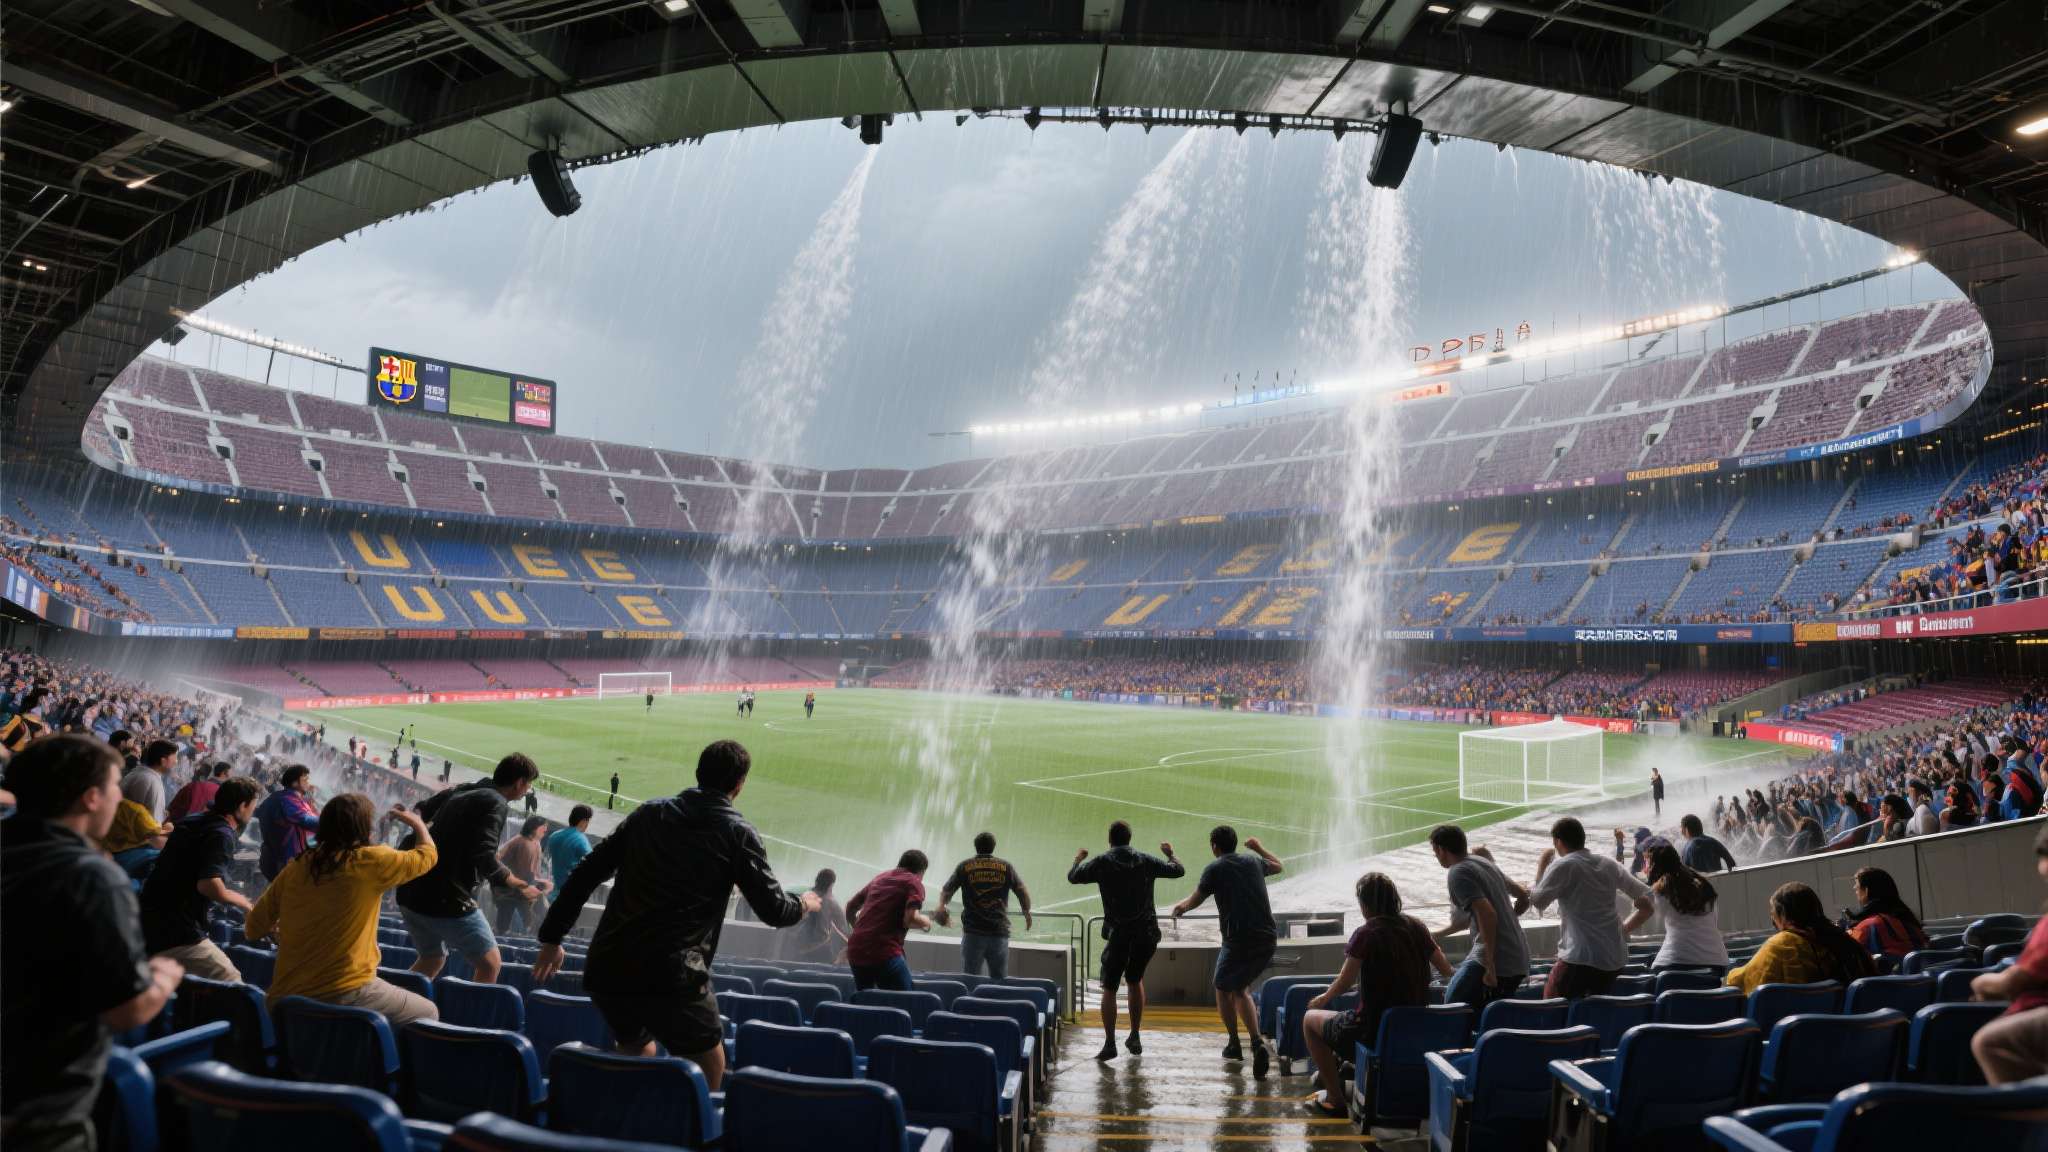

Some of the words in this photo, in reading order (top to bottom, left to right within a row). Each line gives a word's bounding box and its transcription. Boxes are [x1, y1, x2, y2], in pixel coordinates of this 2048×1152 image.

[351, 531, 412, 569] U
[512, 544, 569, 578] E
[582, 548, 636, 580] E
[383, 585, 446, 621] U
[470, 590, 528, 624] U
[616, 595, 673, 627] E
[1103, 594, 1169, 625] U
